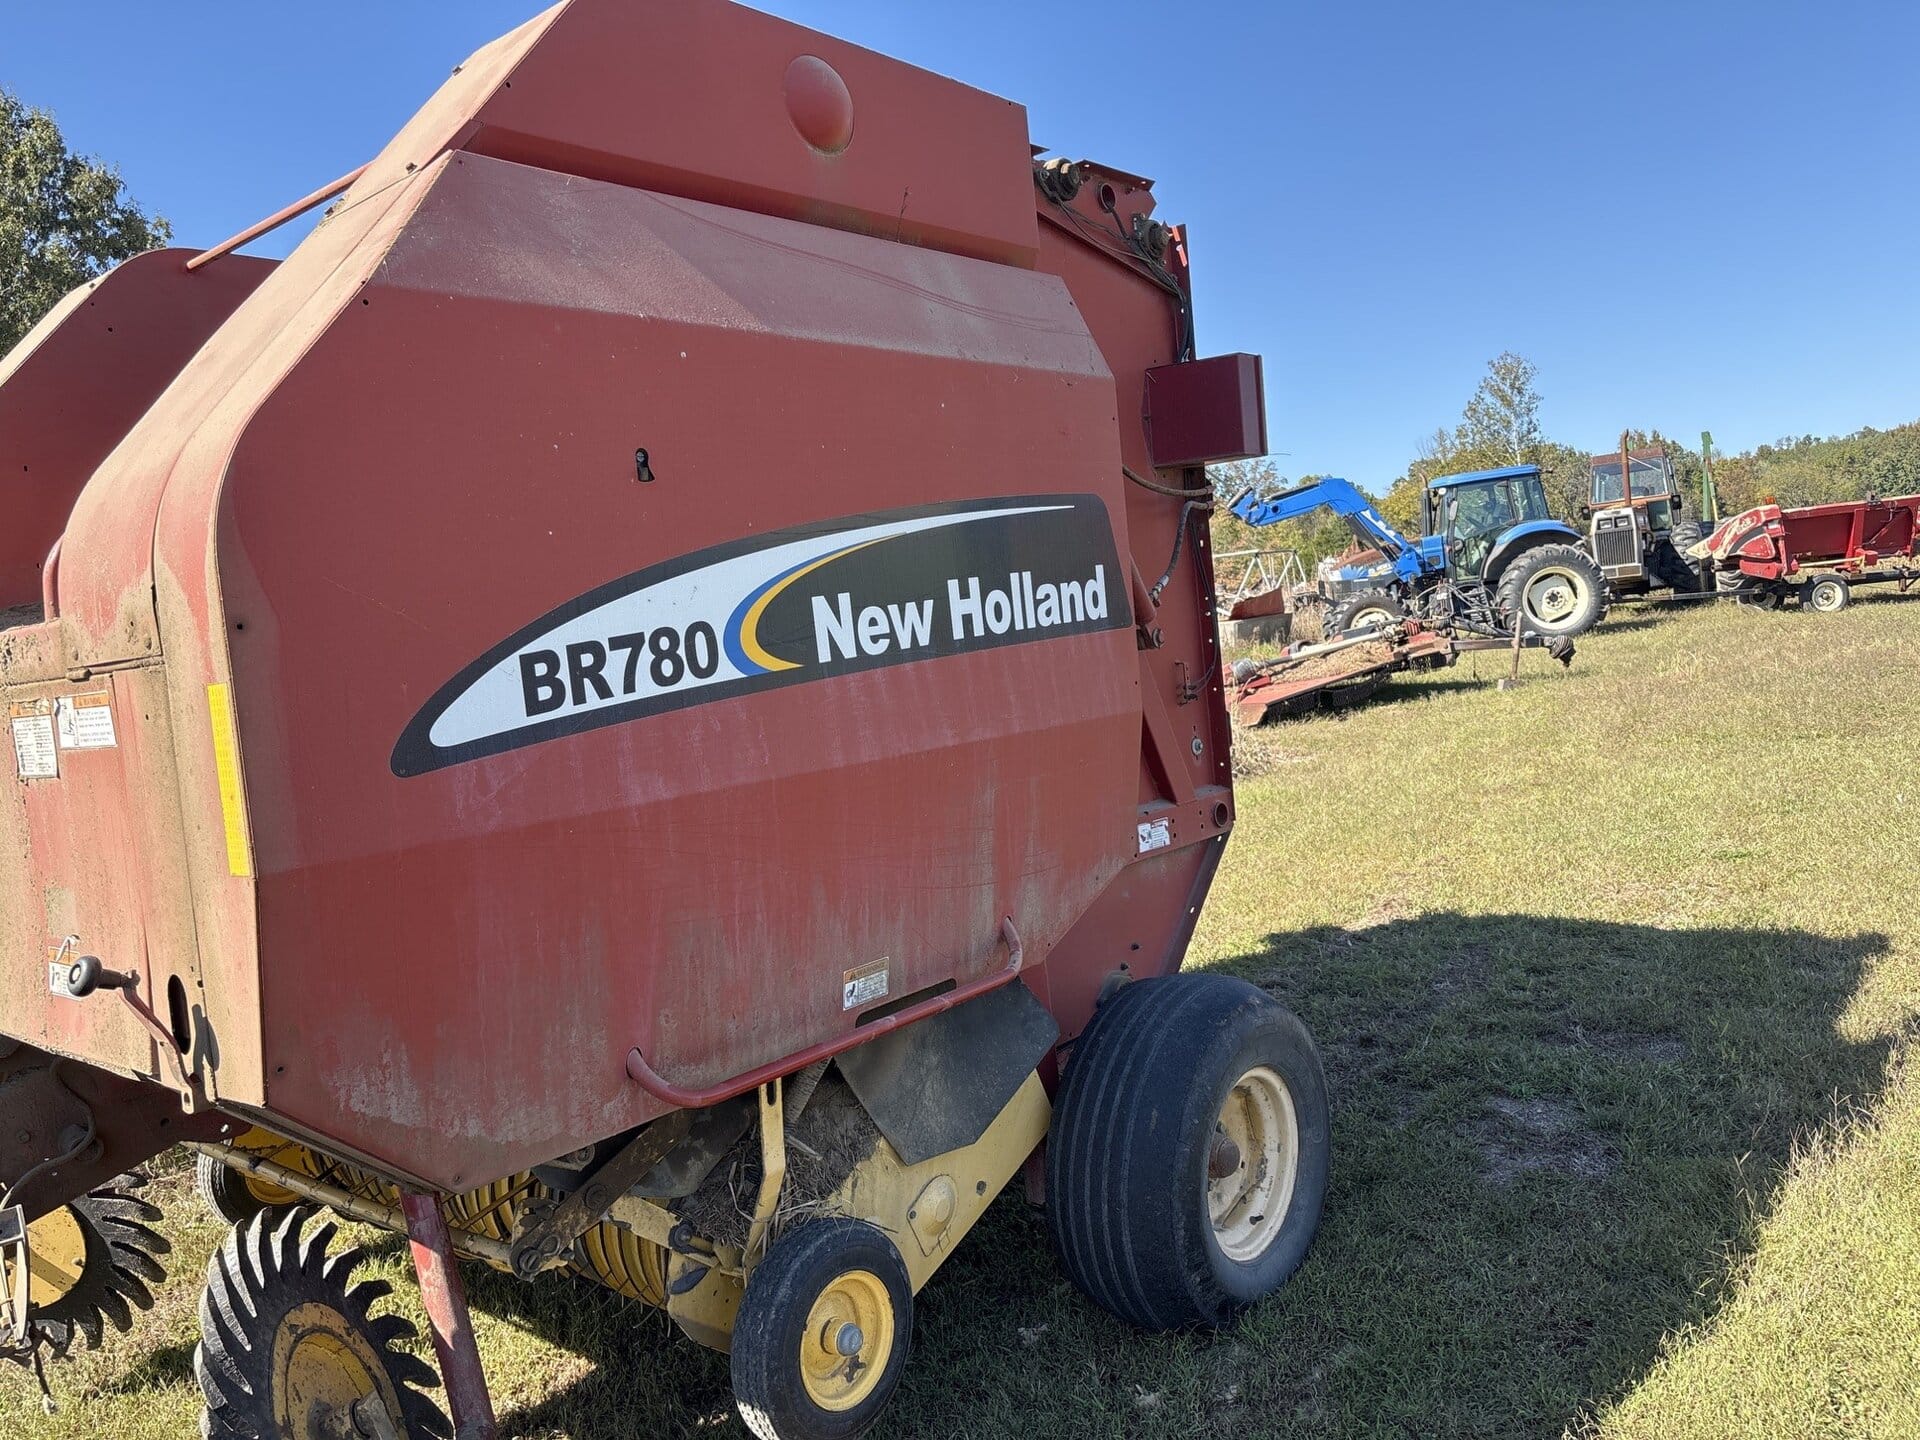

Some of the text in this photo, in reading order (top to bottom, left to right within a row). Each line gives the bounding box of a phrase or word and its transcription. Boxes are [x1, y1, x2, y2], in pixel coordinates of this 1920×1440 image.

[811, 564, 1108, 663] New Holland
[519, 621, 719, 717] BR780
